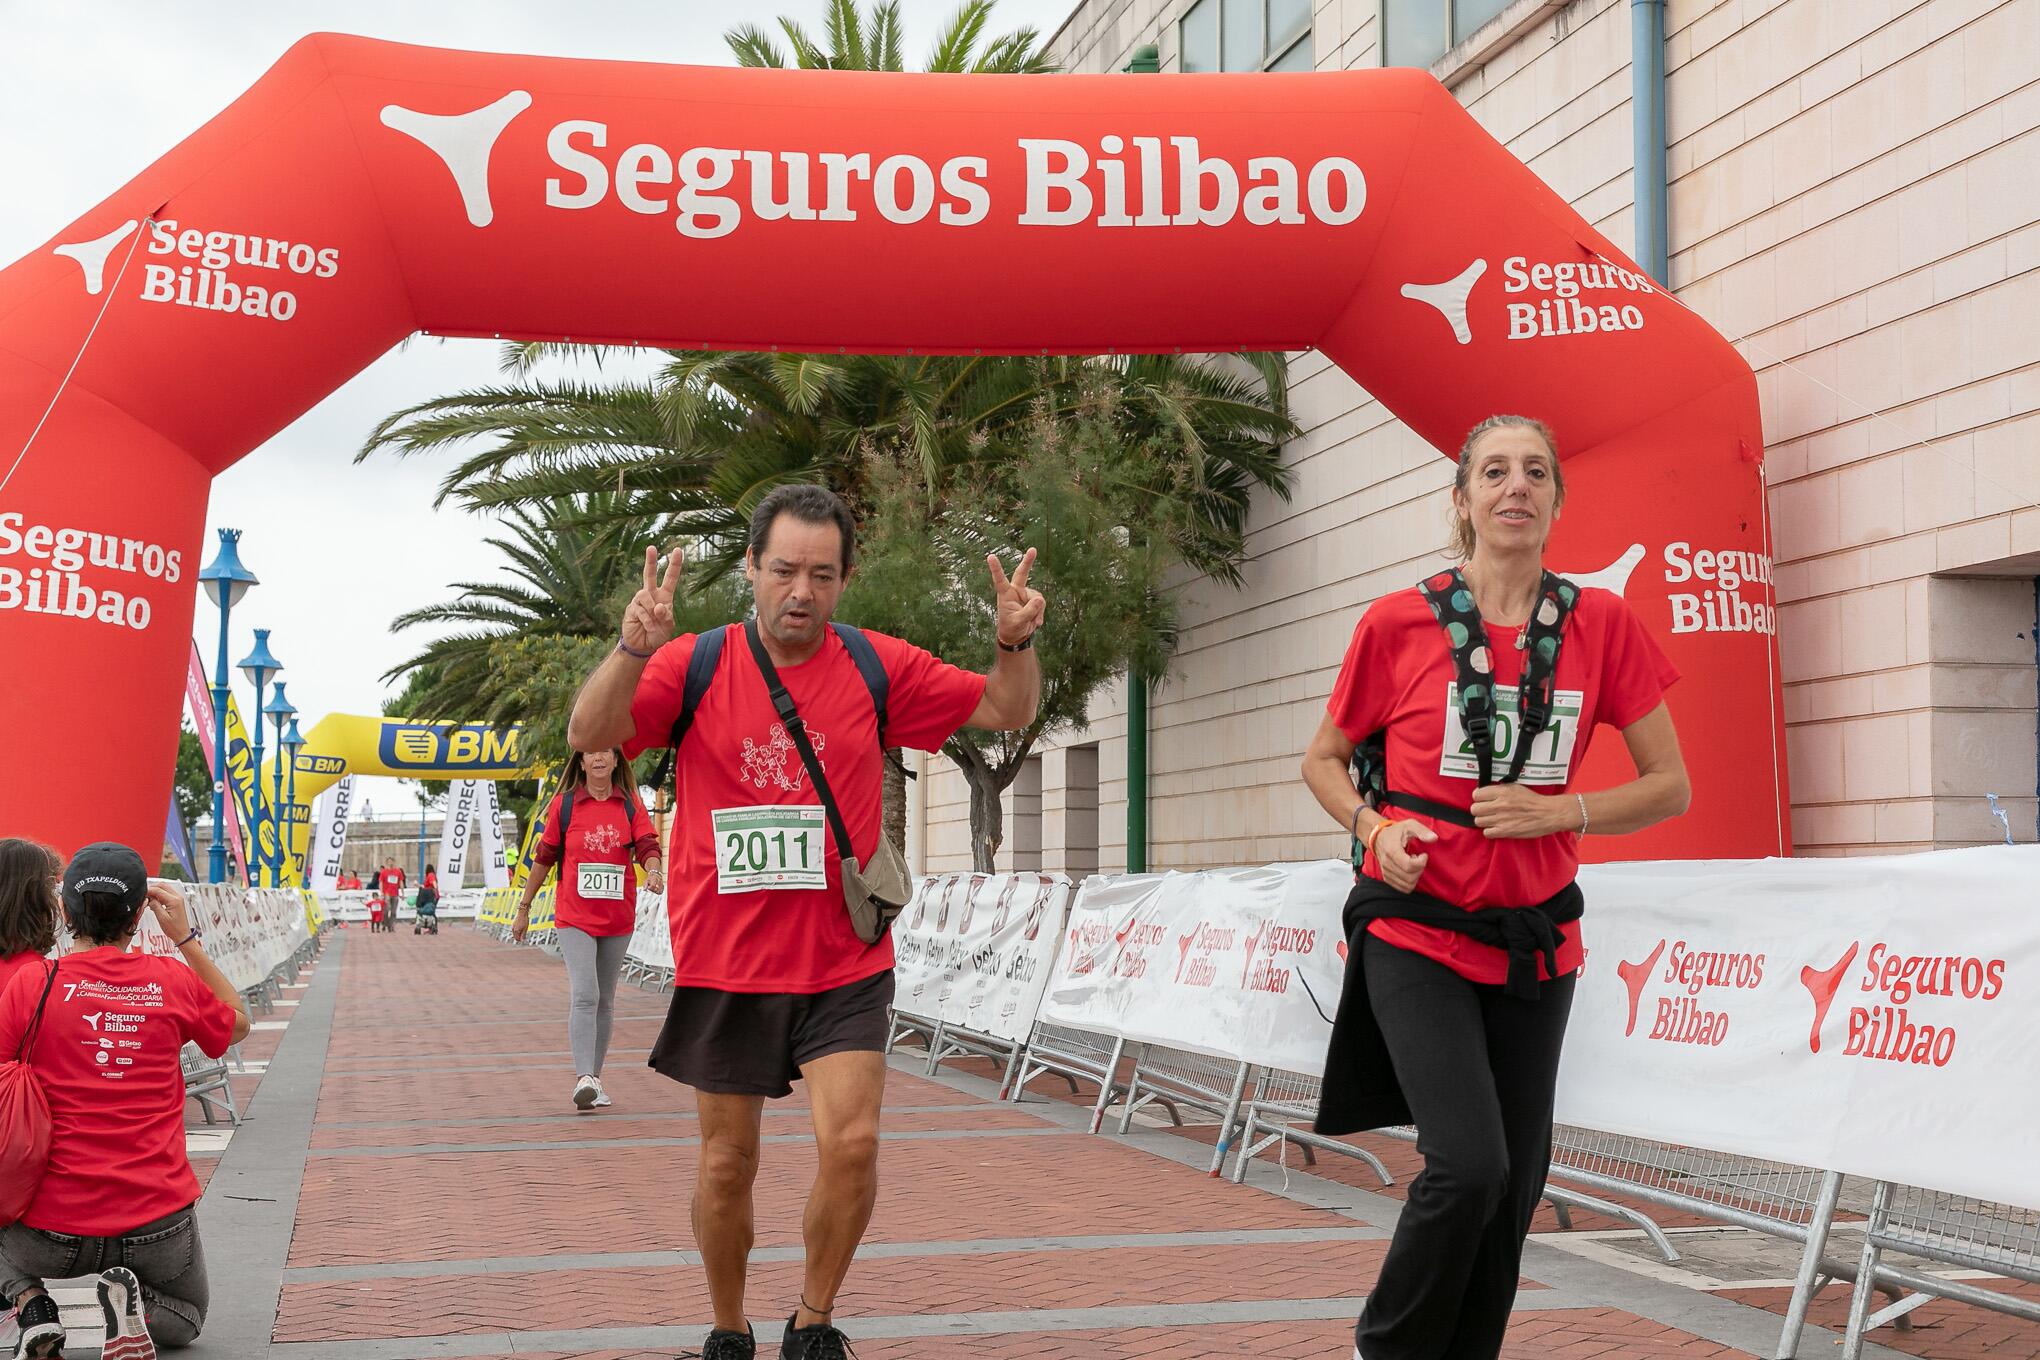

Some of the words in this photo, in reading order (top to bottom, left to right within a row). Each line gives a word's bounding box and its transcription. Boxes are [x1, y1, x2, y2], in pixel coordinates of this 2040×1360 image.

[545, 120, 991, 239] Seguros
[1018, 134, 1367, 227] Bilbao
[148, 219, 340, 278] Seguros
[140, 263, 298, 321] Bilbao
[1503, 256, 1654, 298] Seguros
[1506, 298, 1645, 340] Bilbao
[0, 512, 182, 583] Seguros
[0, 566, 151, 630] Bilbao
[314, 759, 344, 773] BM
[447, 729, 520, 764] BM
[324, 851, 342, 877] EL
[448, 852, 462, 874] EL
[727, 830, 809, 872] 2011
[583, 873, 619, 890] 2011
[1664, 940, 1766, 995] Seguros
[1862, 942, 2006, 1004] Seguros
[104, 1012, 146, 1023] Seguros
[104, 1022, 138, 1032] Bilbao
[1649, 996, 1729, 1046] Bilbao
[1842, 1006, 1957, 1067] Bilbao
